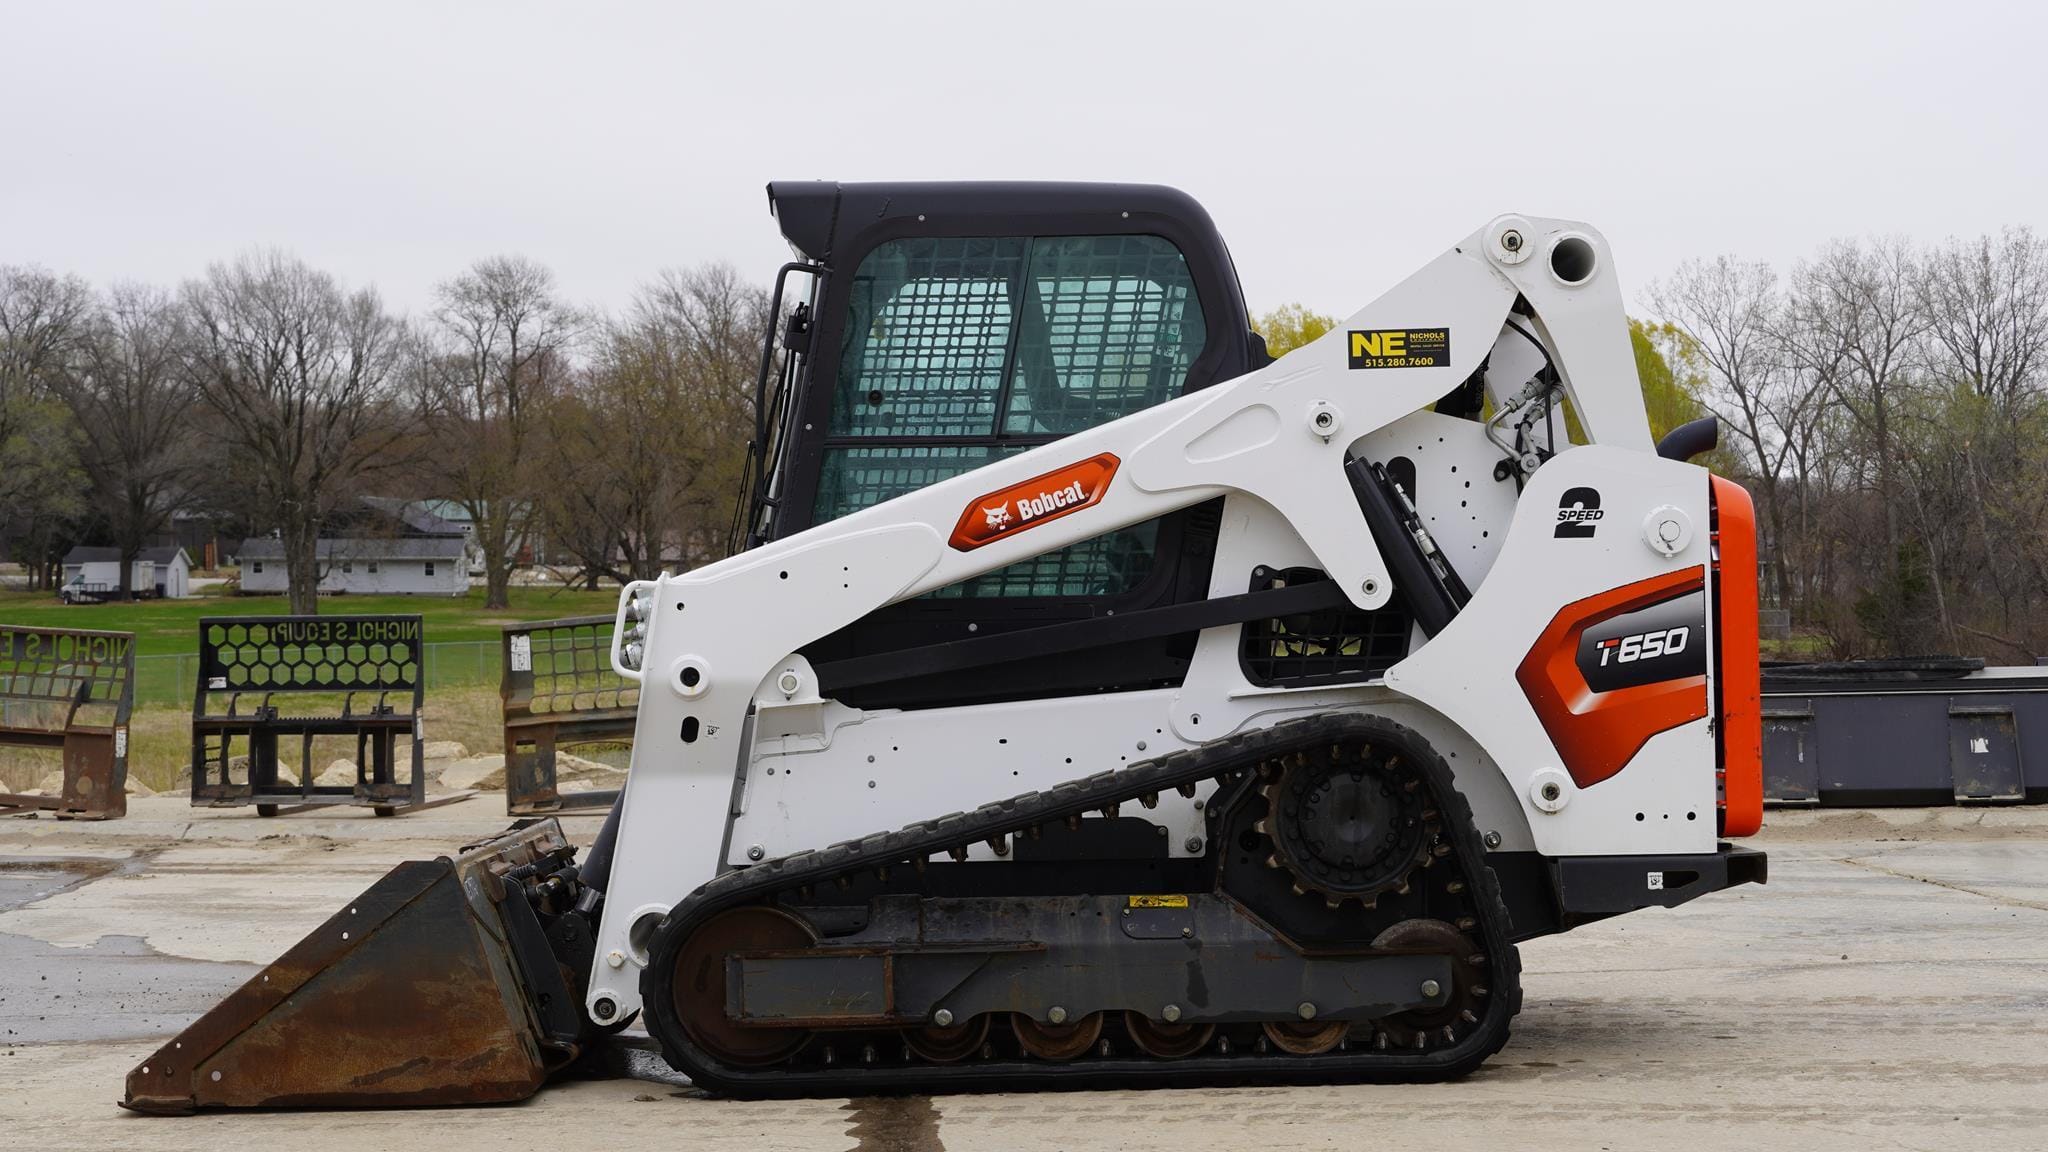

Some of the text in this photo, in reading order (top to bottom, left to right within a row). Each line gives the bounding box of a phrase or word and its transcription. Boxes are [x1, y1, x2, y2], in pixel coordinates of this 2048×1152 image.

[1352, 332, 1406, 357] NE
[1365, 357, 1434, 367] 515.280.7600
[1016, 480, 1086, 521] Bobcat
[1554, 487, 1601, 538] 2
[1557, 510, 1604, 521] SPEED
[1596, 626, 1690, 667] T650
